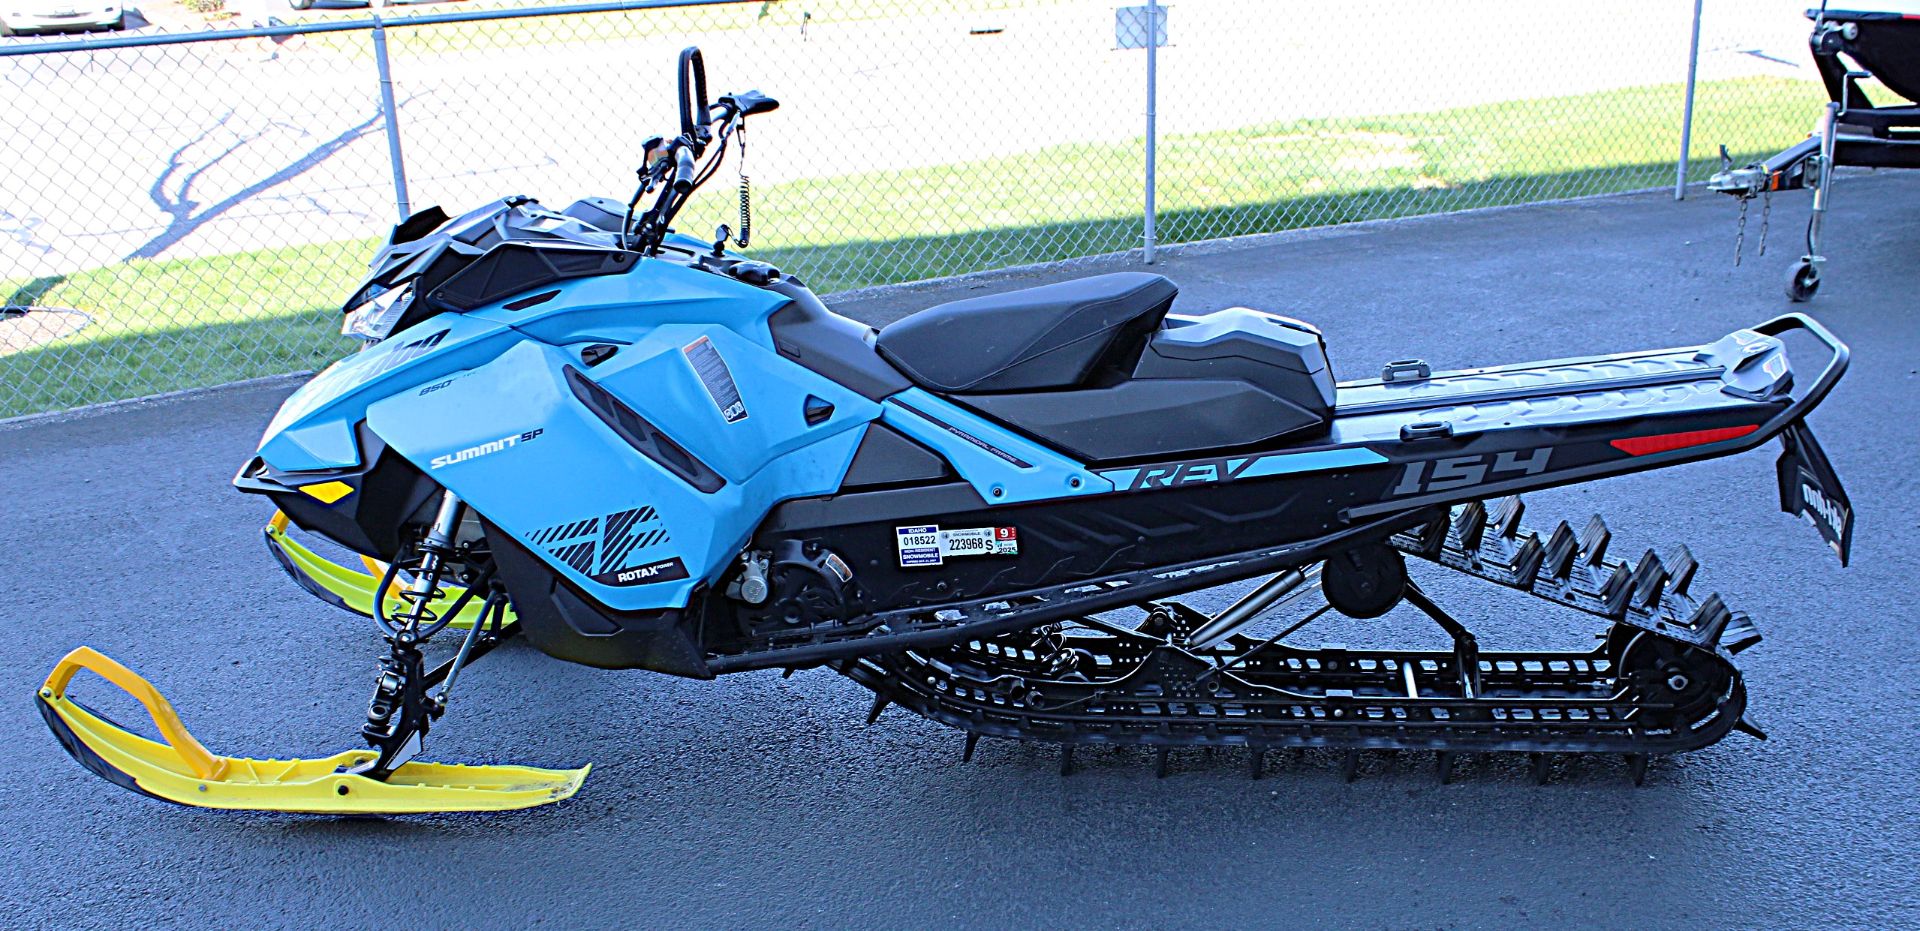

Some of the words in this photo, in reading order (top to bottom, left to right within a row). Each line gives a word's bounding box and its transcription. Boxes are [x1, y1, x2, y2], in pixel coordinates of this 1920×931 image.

[419, 380, 452, 396] 850
[431, 434, 521, 470] SUMMIT
[521, 428, 544, 442] SP
[1128, 455, 1262, 491] REV
[1393, 447, 1553, 495] 154
[903, 535, 936, 546] 018522
[1000, 528, 1009, 537] 9
[949, 538, 984, 550] 223968
[985, 539, 994, 551] S
[618, 566, 658, 583] ROTAX
